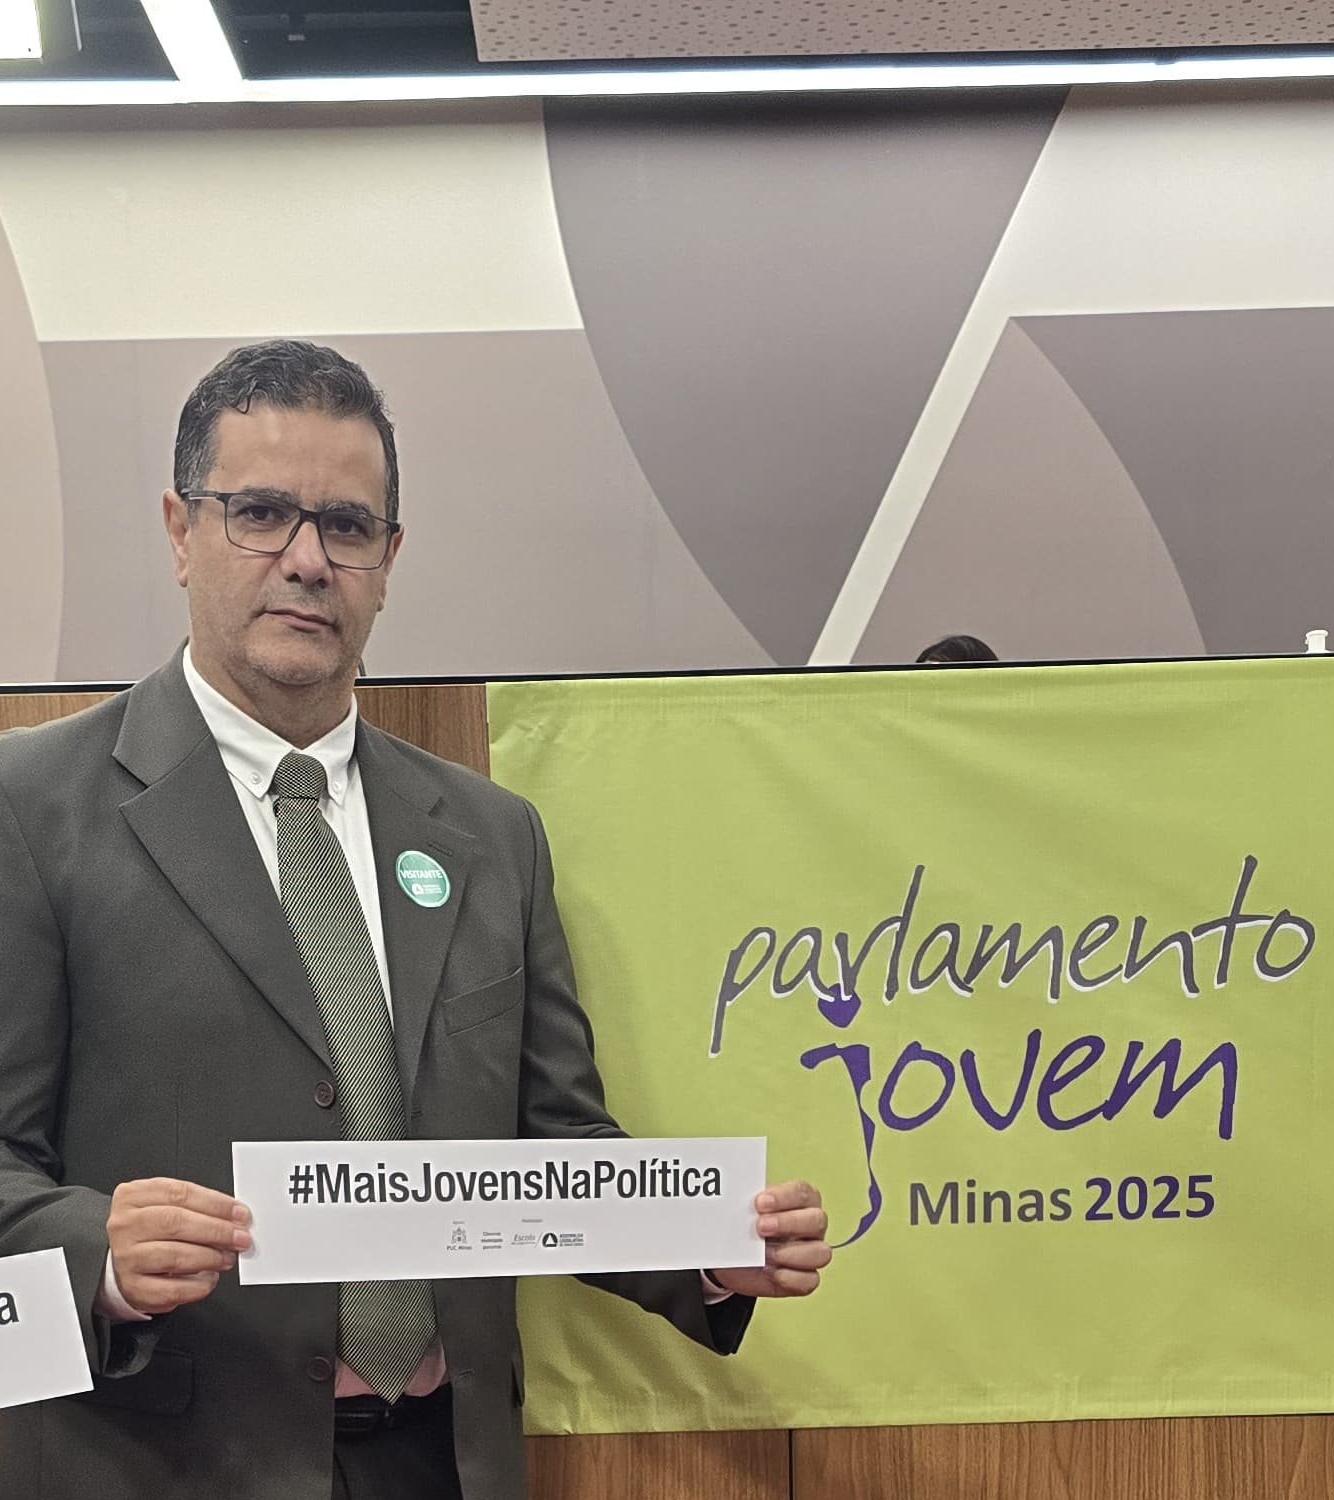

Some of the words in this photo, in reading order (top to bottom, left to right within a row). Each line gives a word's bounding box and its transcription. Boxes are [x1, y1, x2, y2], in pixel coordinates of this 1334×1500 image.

[709, 854, 1317, 1058] parlamento
[800, 984, 1238, 1249] jovem
[288, 1159, 722, 1205] #MaisJovensNaPolítica
[910, 1179, 1072, 1226] Minas
[1084, 1174, 1215, 1221] 2025
